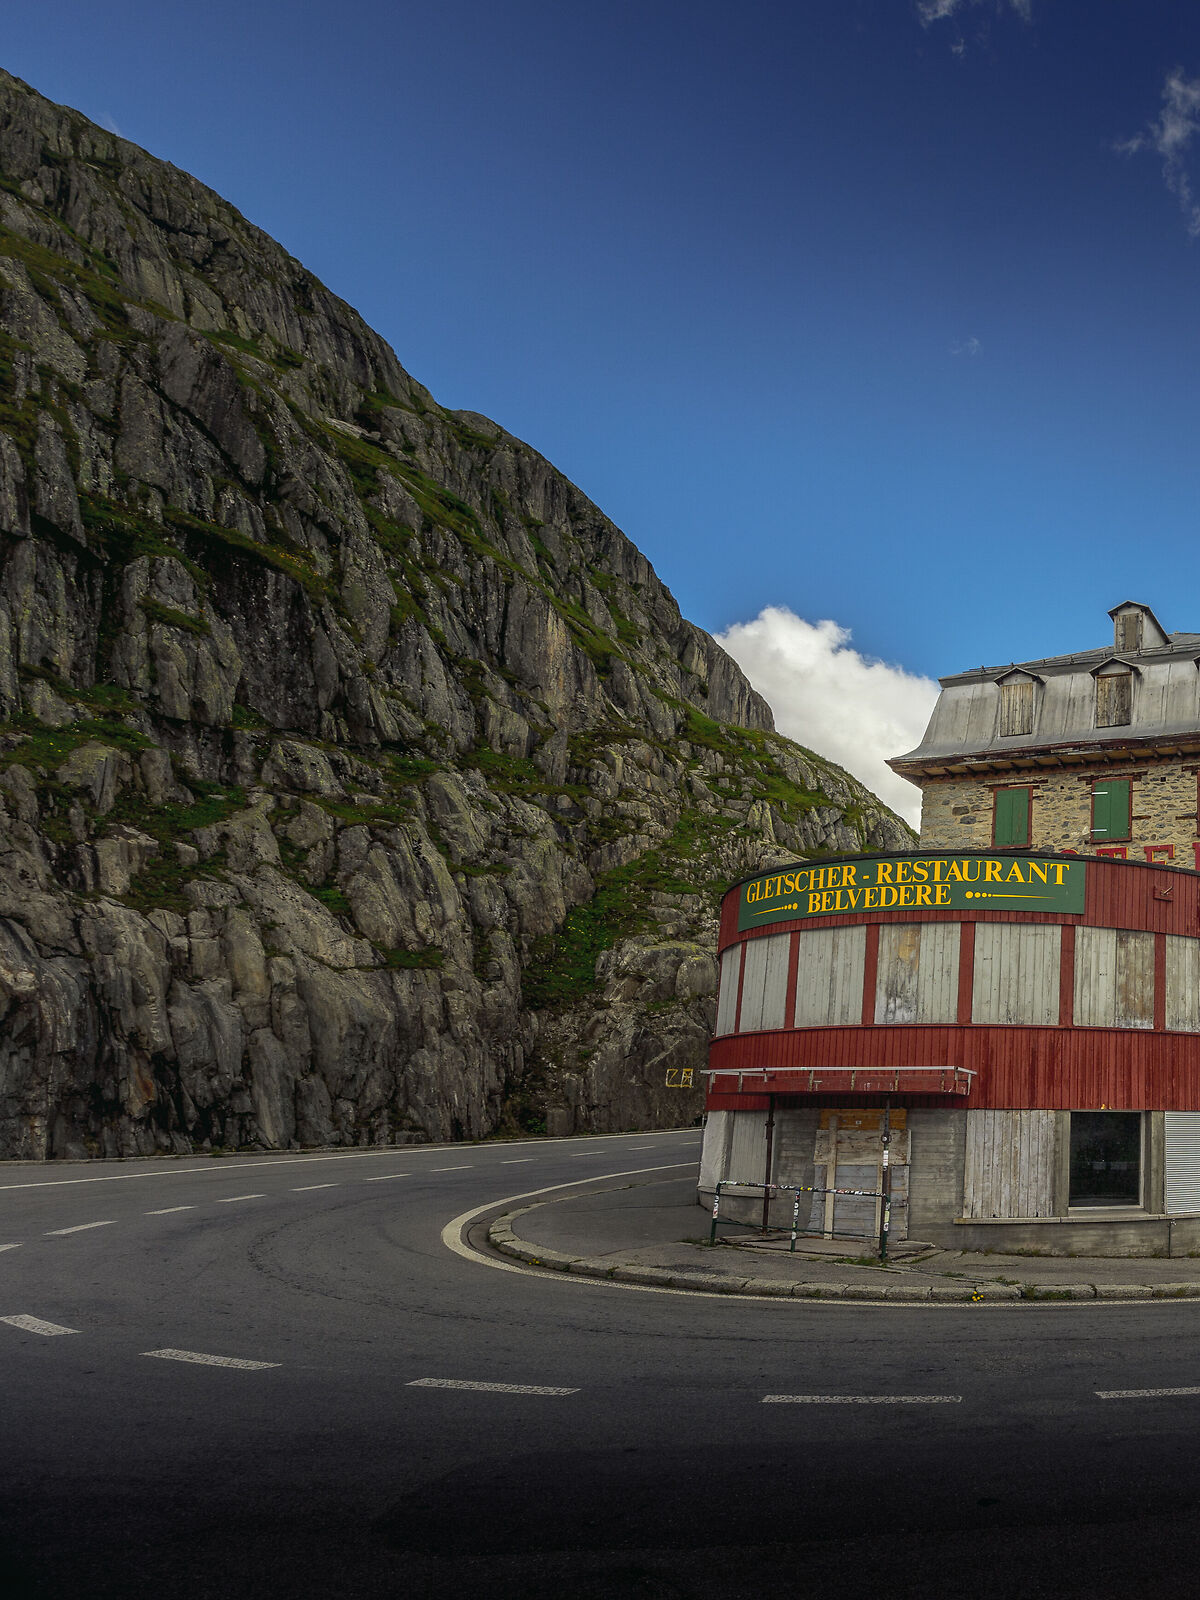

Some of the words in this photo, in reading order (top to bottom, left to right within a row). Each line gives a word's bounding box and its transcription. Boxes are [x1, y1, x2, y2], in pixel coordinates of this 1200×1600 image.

[746, 865, 857, 904] GLETSCHER
[875, 860, 1070, 885] RESTAURANT
[806, 884, 952, 914] BELVEDERE
